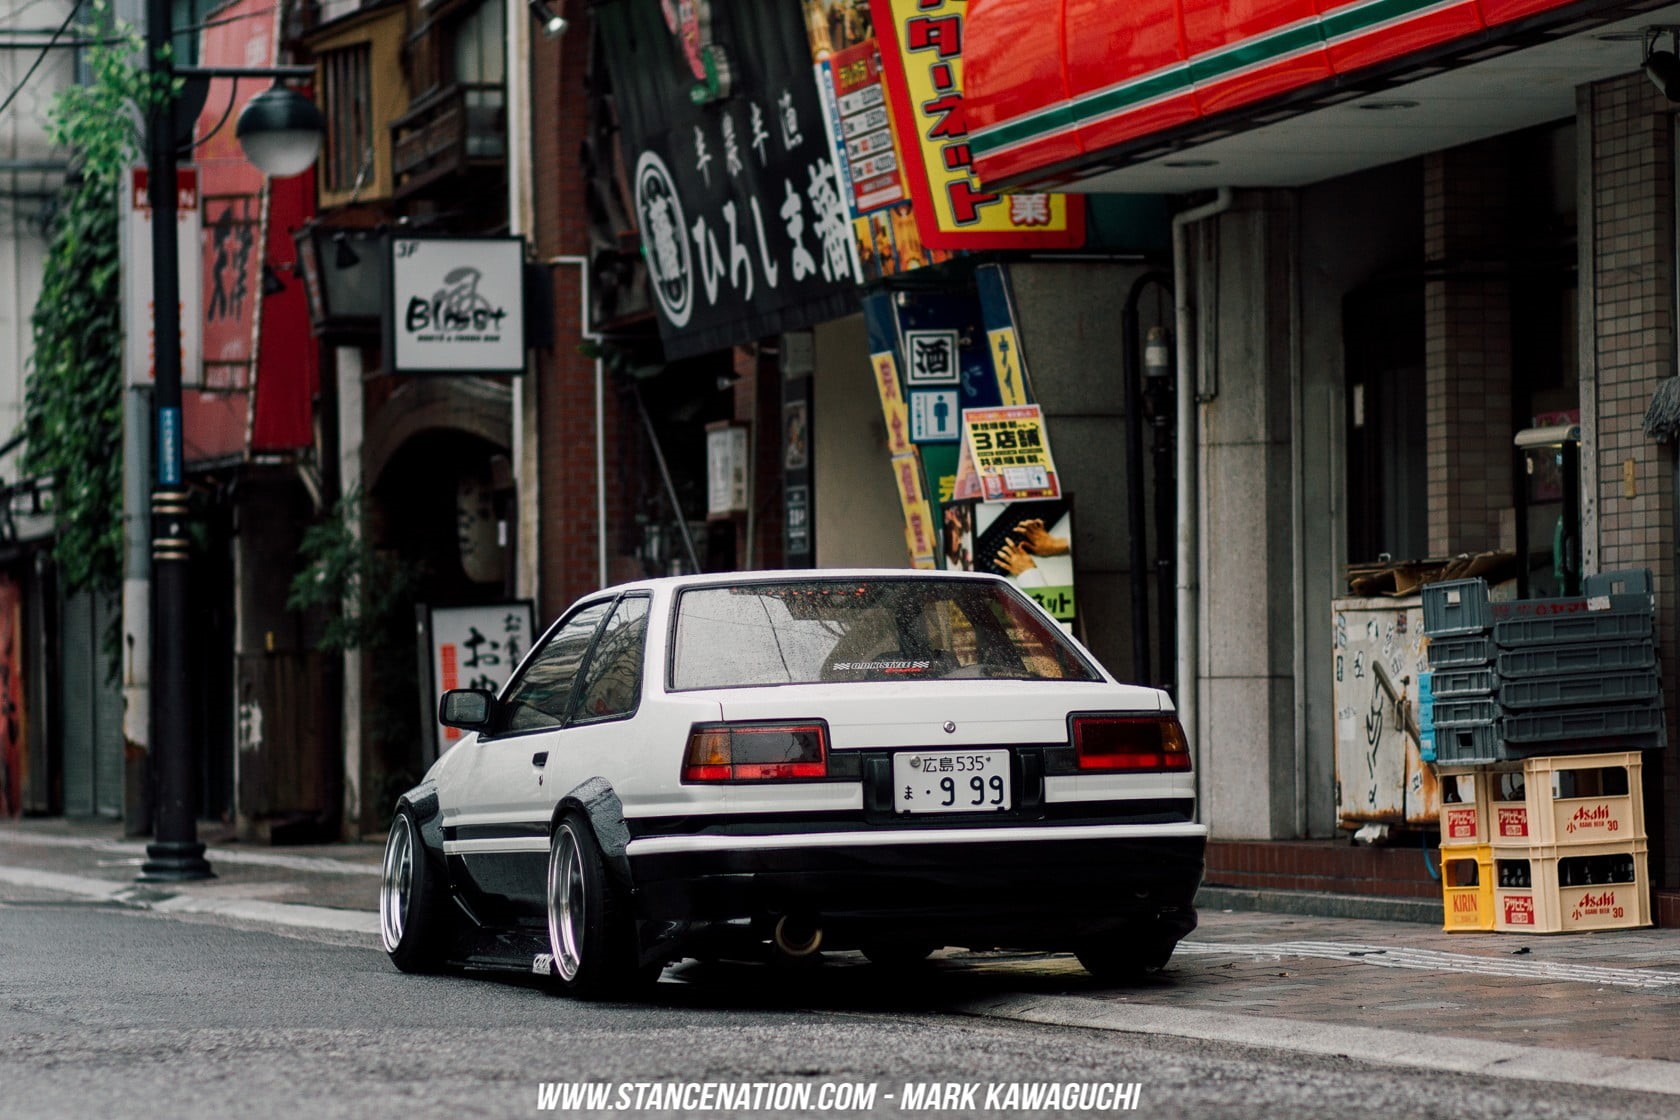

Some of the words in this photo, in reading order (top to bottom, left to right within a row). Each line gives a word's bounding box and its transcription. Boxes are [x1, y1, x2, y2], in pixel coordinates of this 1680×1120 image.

[906, 0, 1002, 227] ターネット
[916, 339, 949, 374] 酒
[973, 429, 1041, 450] 3店舗
[904, 785, 914, 800] ま
[1573, 805, 1610, 821] Asahi
[1566, 823, 1577, 834] 小
[1607, 820, 1618, 831] 30
[1453, 894, 1478, 913] KIRIN
[1579, 892, 1615, 908] Asahi
[1572, 909, 1582, 921] 小
[1613, 906, 1624, 918] 30
